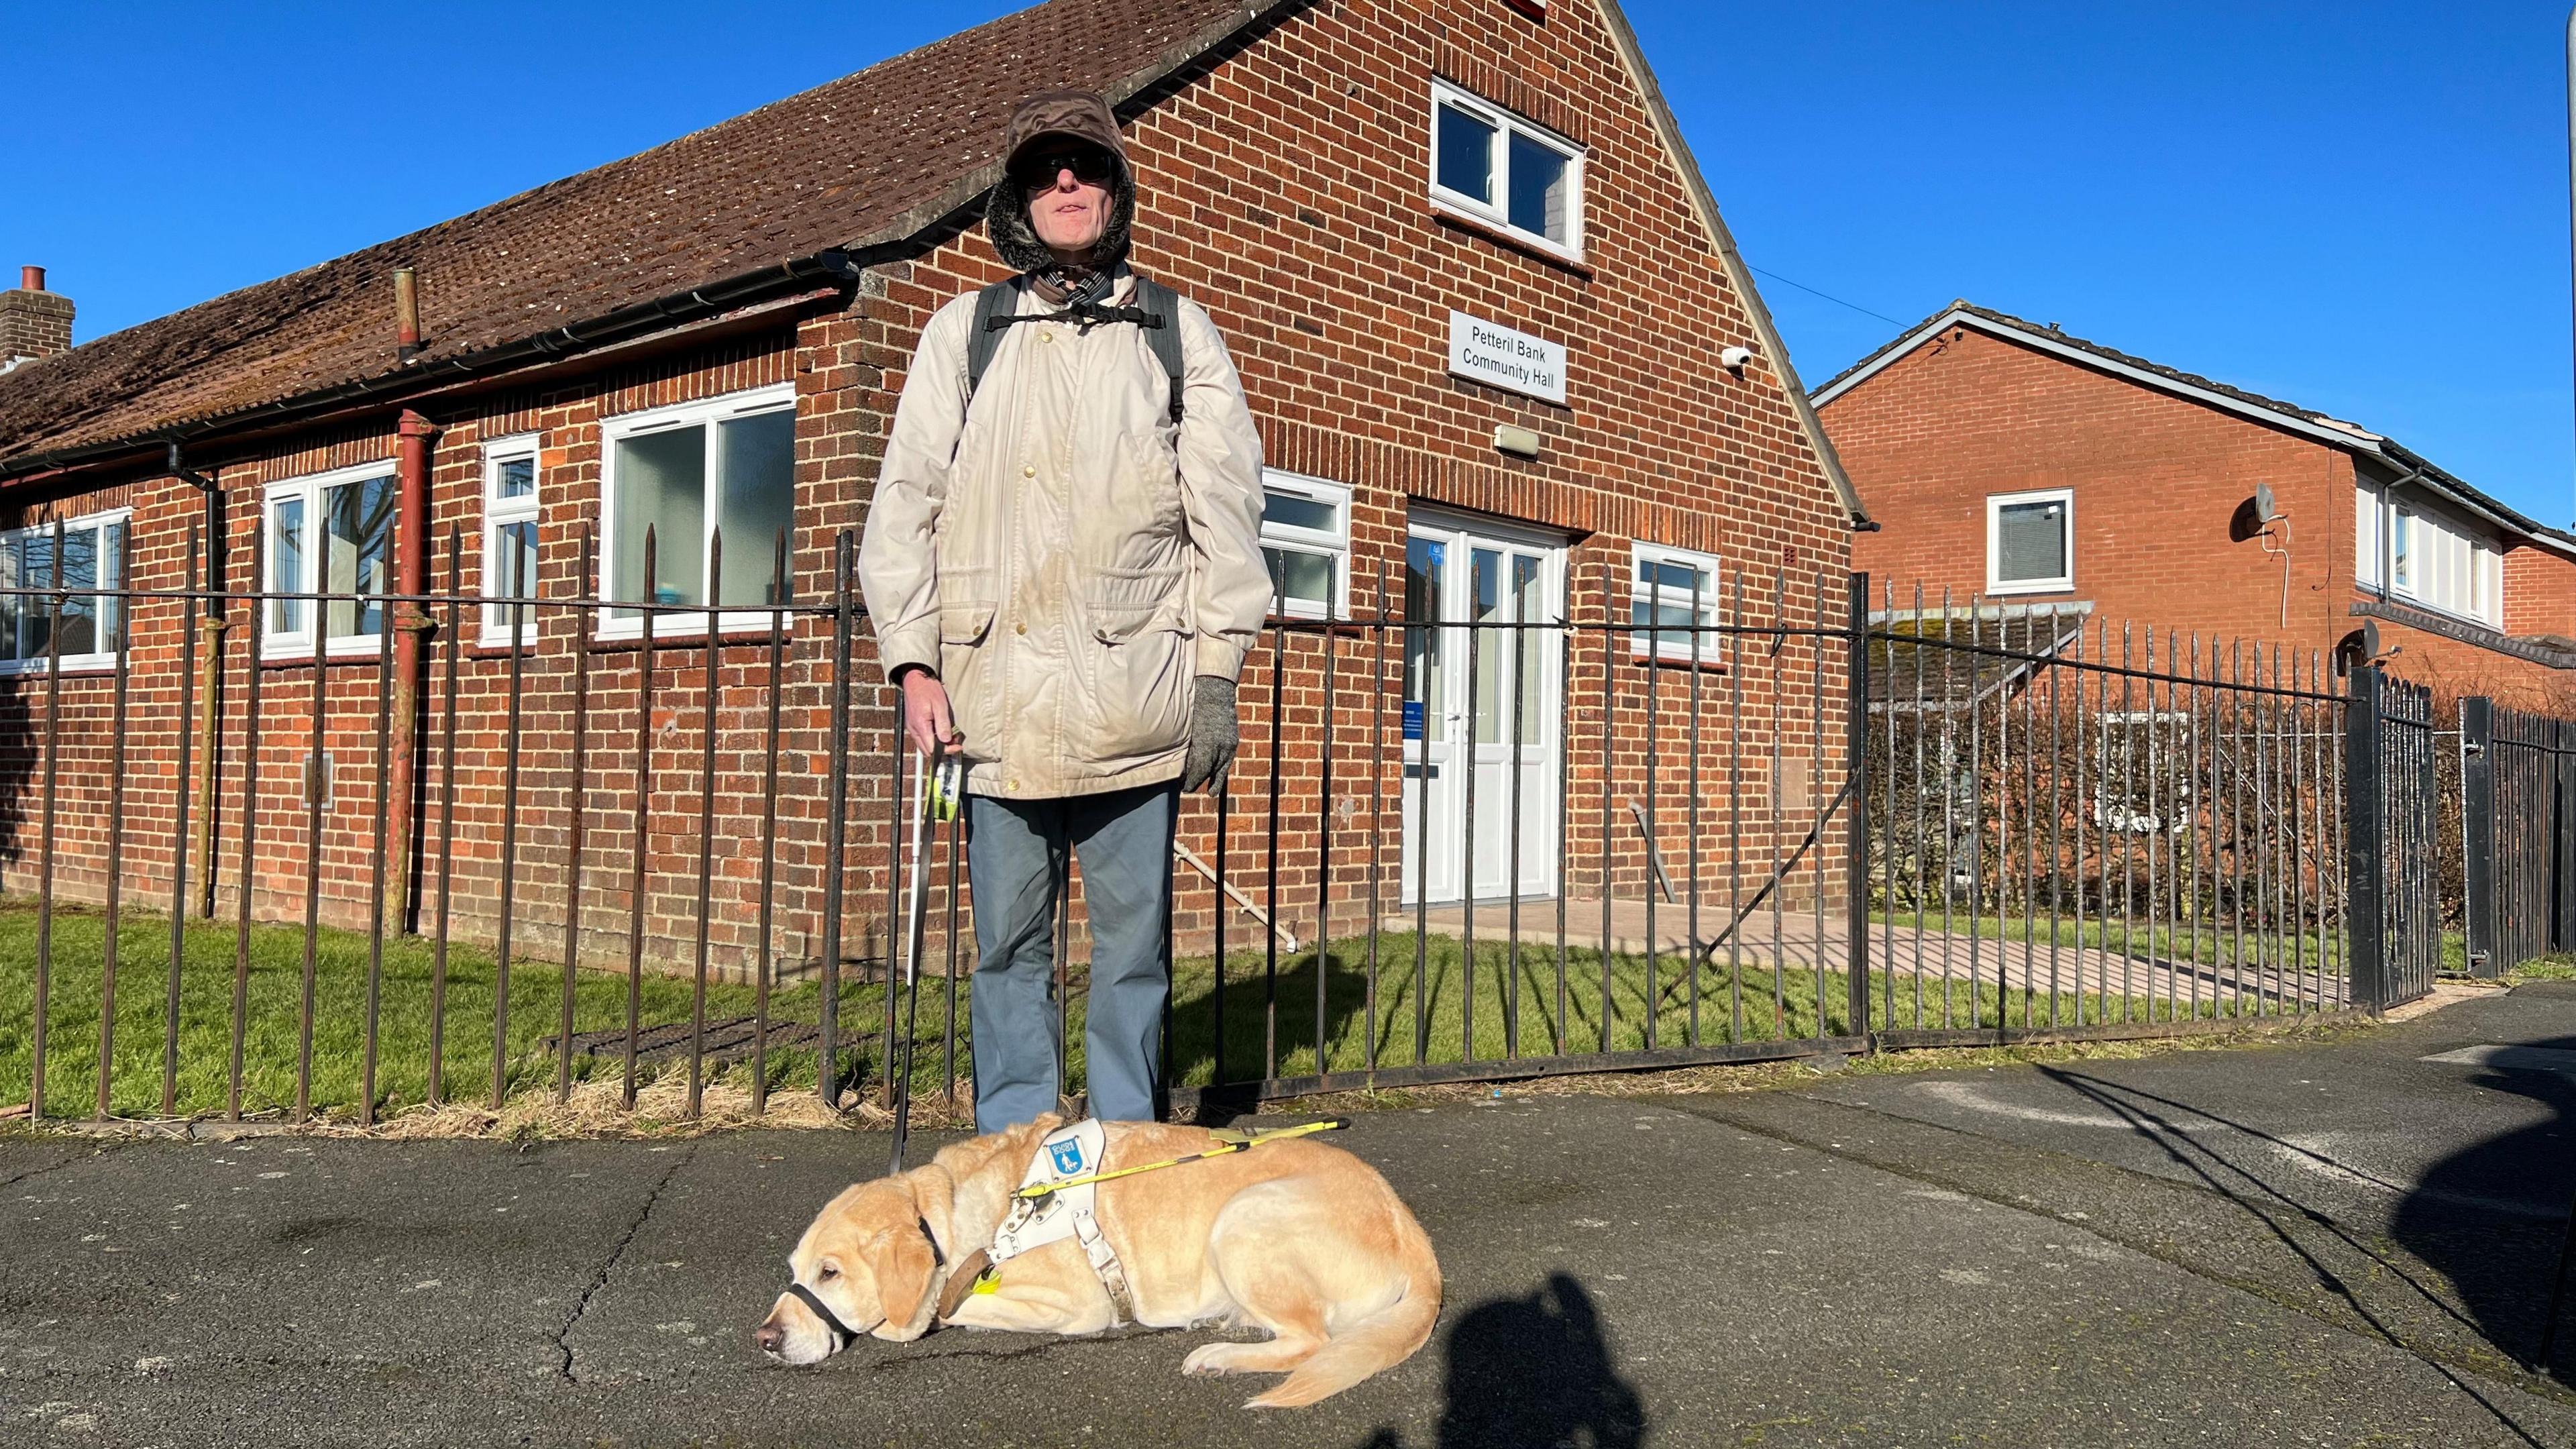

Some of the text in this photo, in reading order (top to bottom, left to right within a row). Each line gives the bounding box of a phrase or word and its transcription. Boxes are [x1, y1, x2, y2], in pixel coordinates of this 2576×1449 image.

[1472, 326, 1546, 363] Petteril Bank
[1463, 347, 1554, 388] Community Hall
[1051, 1141, 1074, 1150] GUIDE
[1053, 1144, 1075, 1155] DOGS
